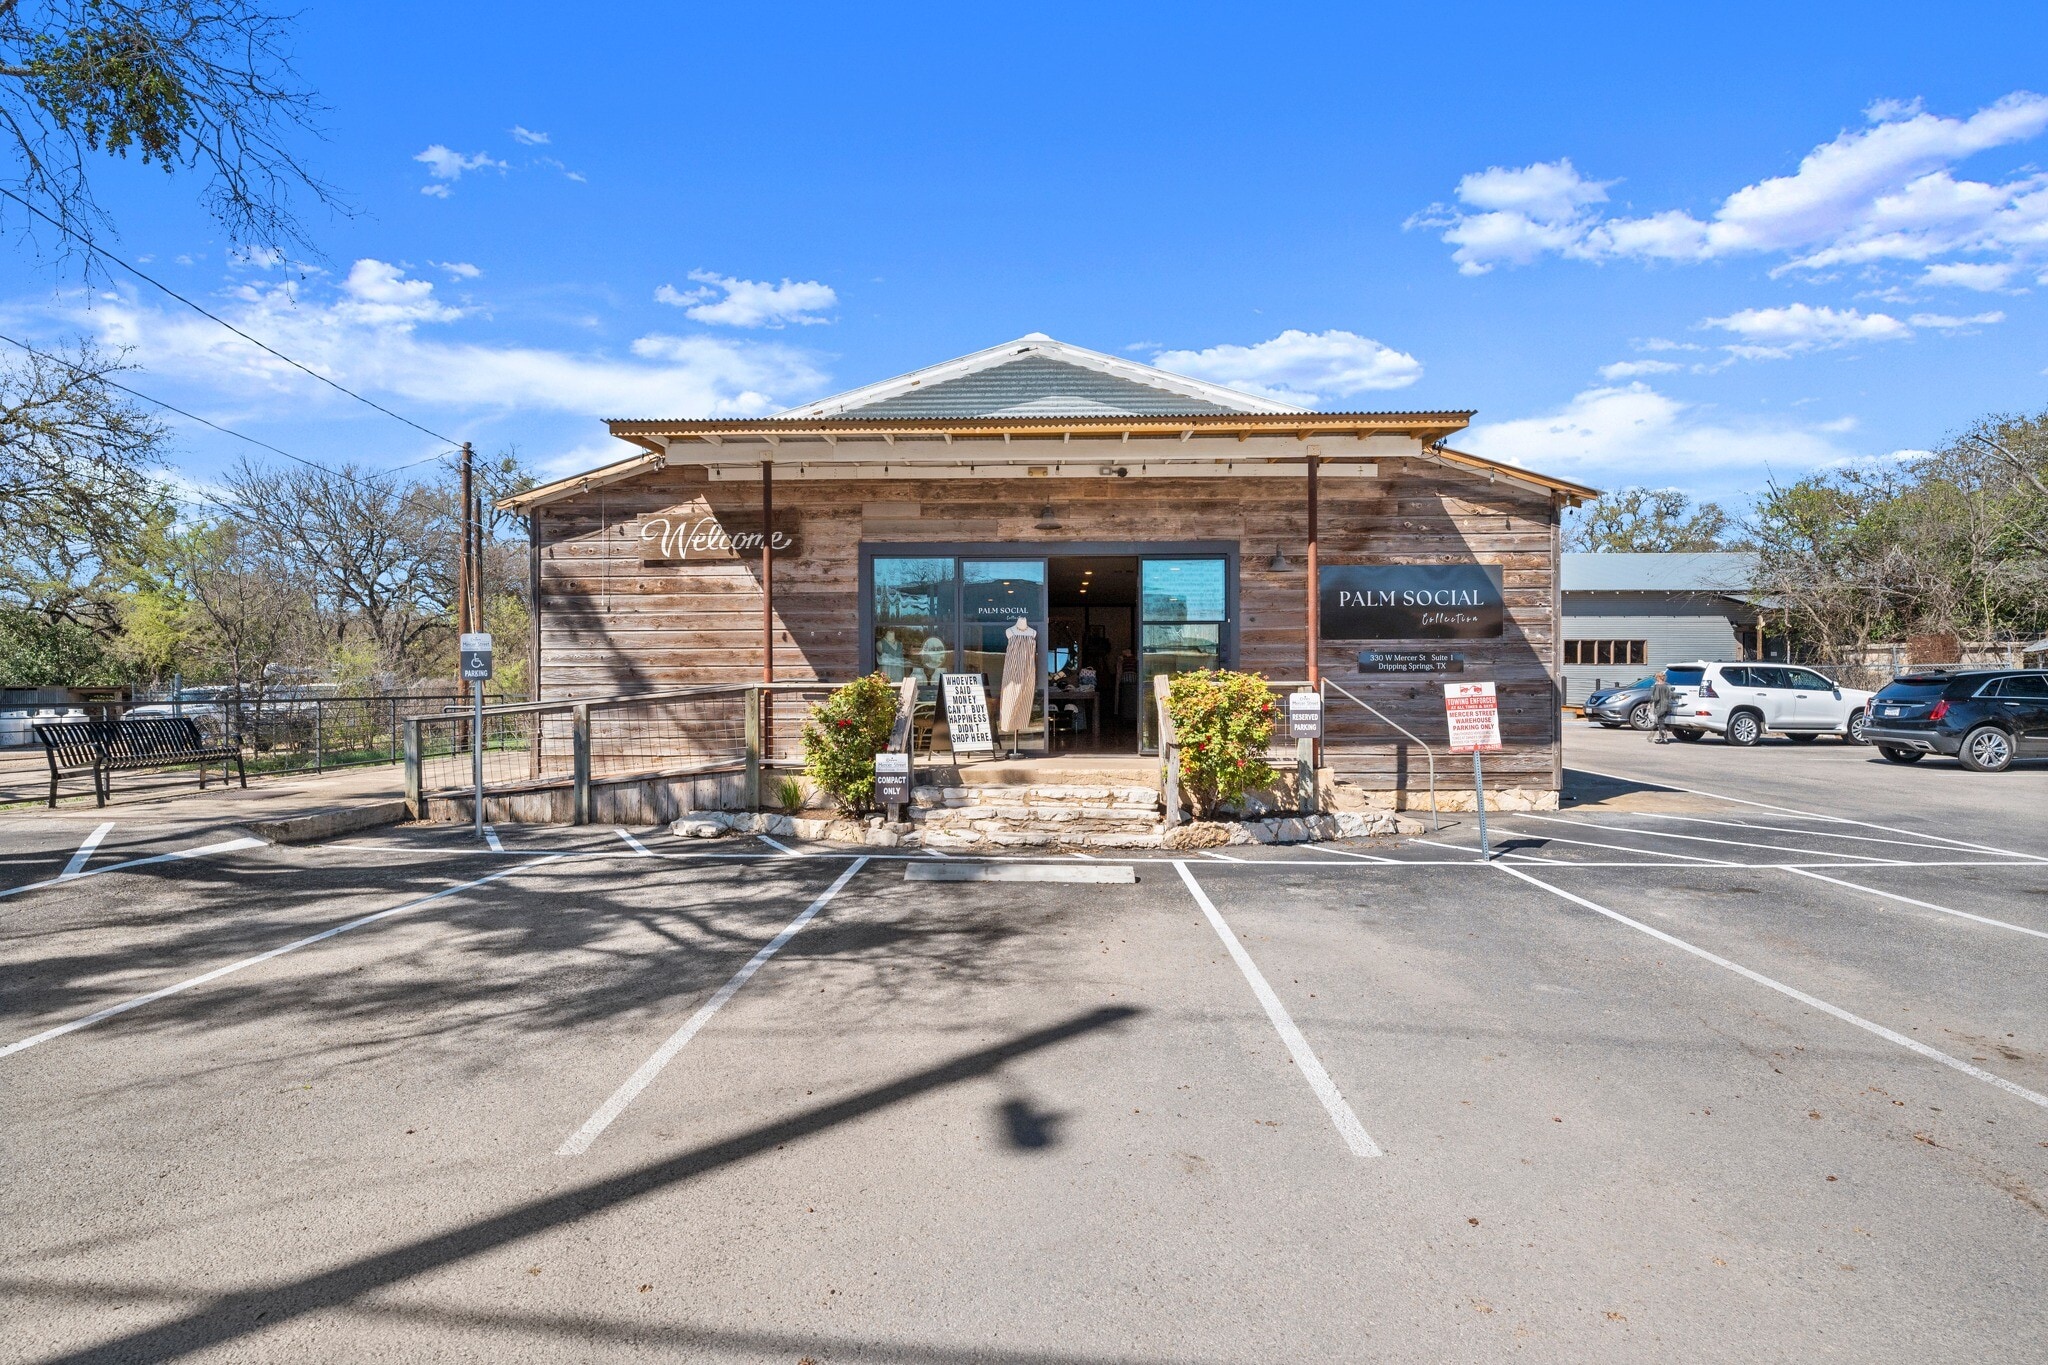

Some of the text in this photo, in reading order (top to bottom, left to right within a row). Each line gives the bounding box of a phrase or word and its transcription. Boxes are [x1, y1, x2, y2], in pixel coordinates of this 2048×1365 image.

[641, 516, 793, 560] Welcome
[1339, 589, 1485, 607] PALM SOCIAL
[1421, 612, 1479, 626] Collection
[1378, 663, 1407, 671] Dripping
[945, 676, 978, 686] WHOEVER
[955, 686, 972, 695] SAID
[952, 695, 977, 704] MONEY
[1447, 696, 1496, 706] TOWING ENFORCED
[971, 705, 985, 713] BUY
[948, 714, 987, 724] HAPPINESS
[951, 732, 992, 743] SHOP HERE.
[883, 787, 901, 795] ONLY
